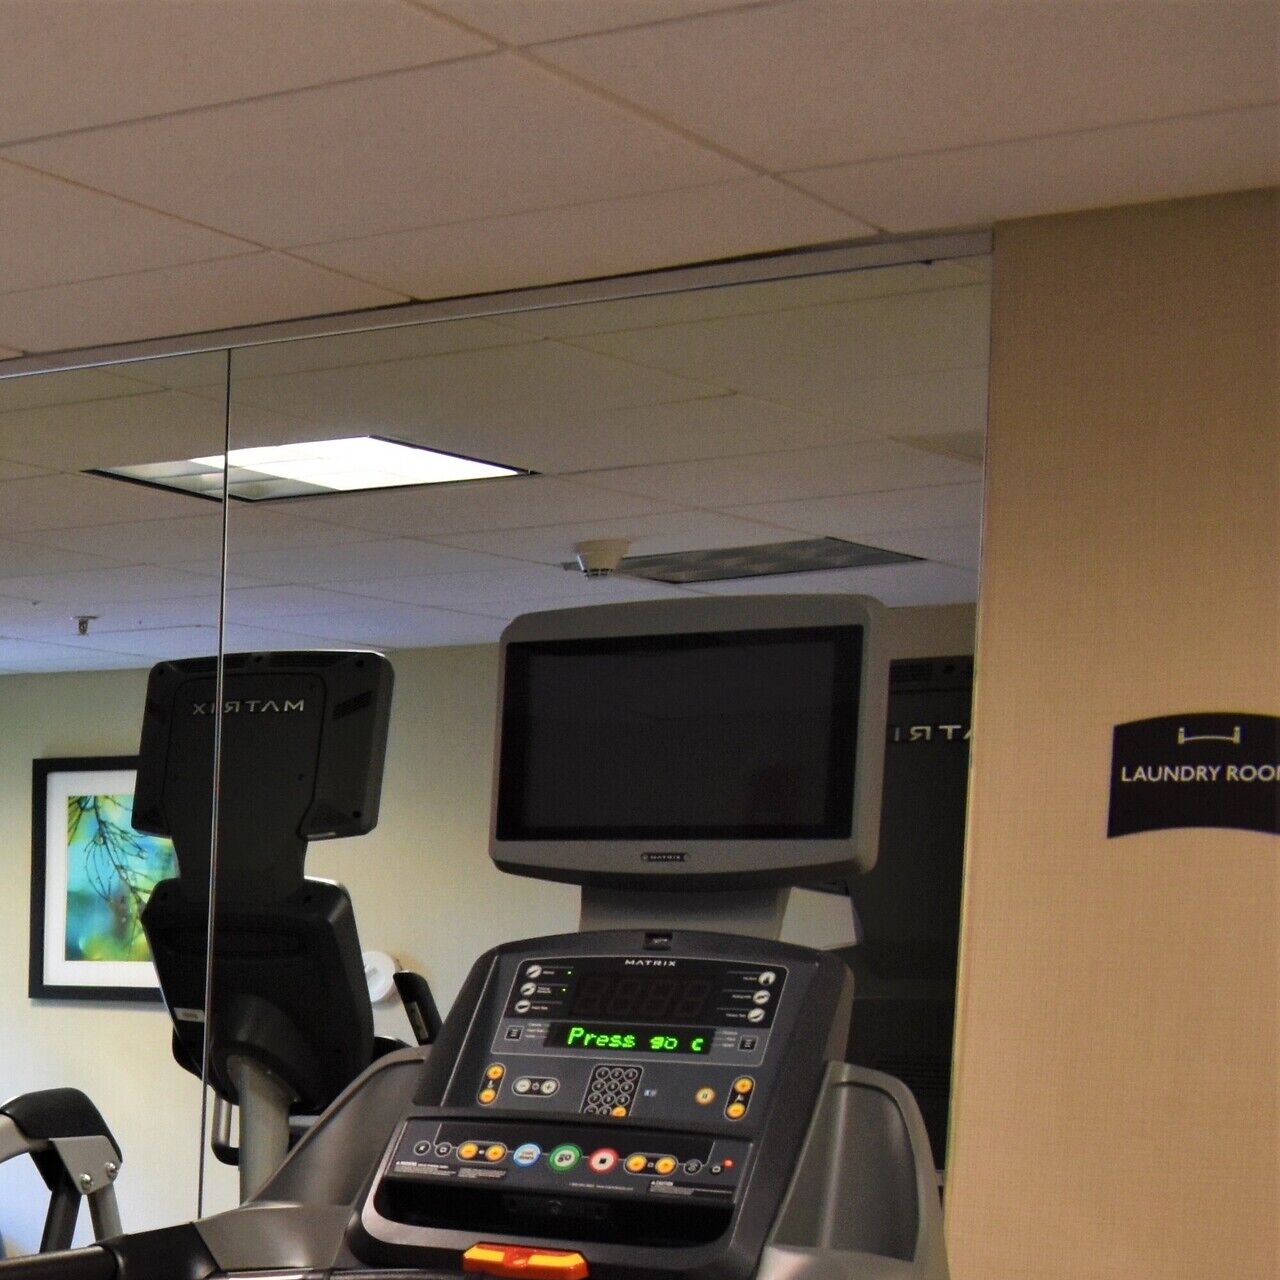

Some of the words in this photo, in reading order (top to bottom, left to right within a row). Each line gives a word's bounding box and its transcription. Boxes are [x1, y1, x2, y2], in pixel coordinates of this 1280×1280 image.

[1121, 765, 1221, 782] LAUNDRY
[624, 959, 677, 967] MATRIX
[567, 1027, 636, 1048] Press
